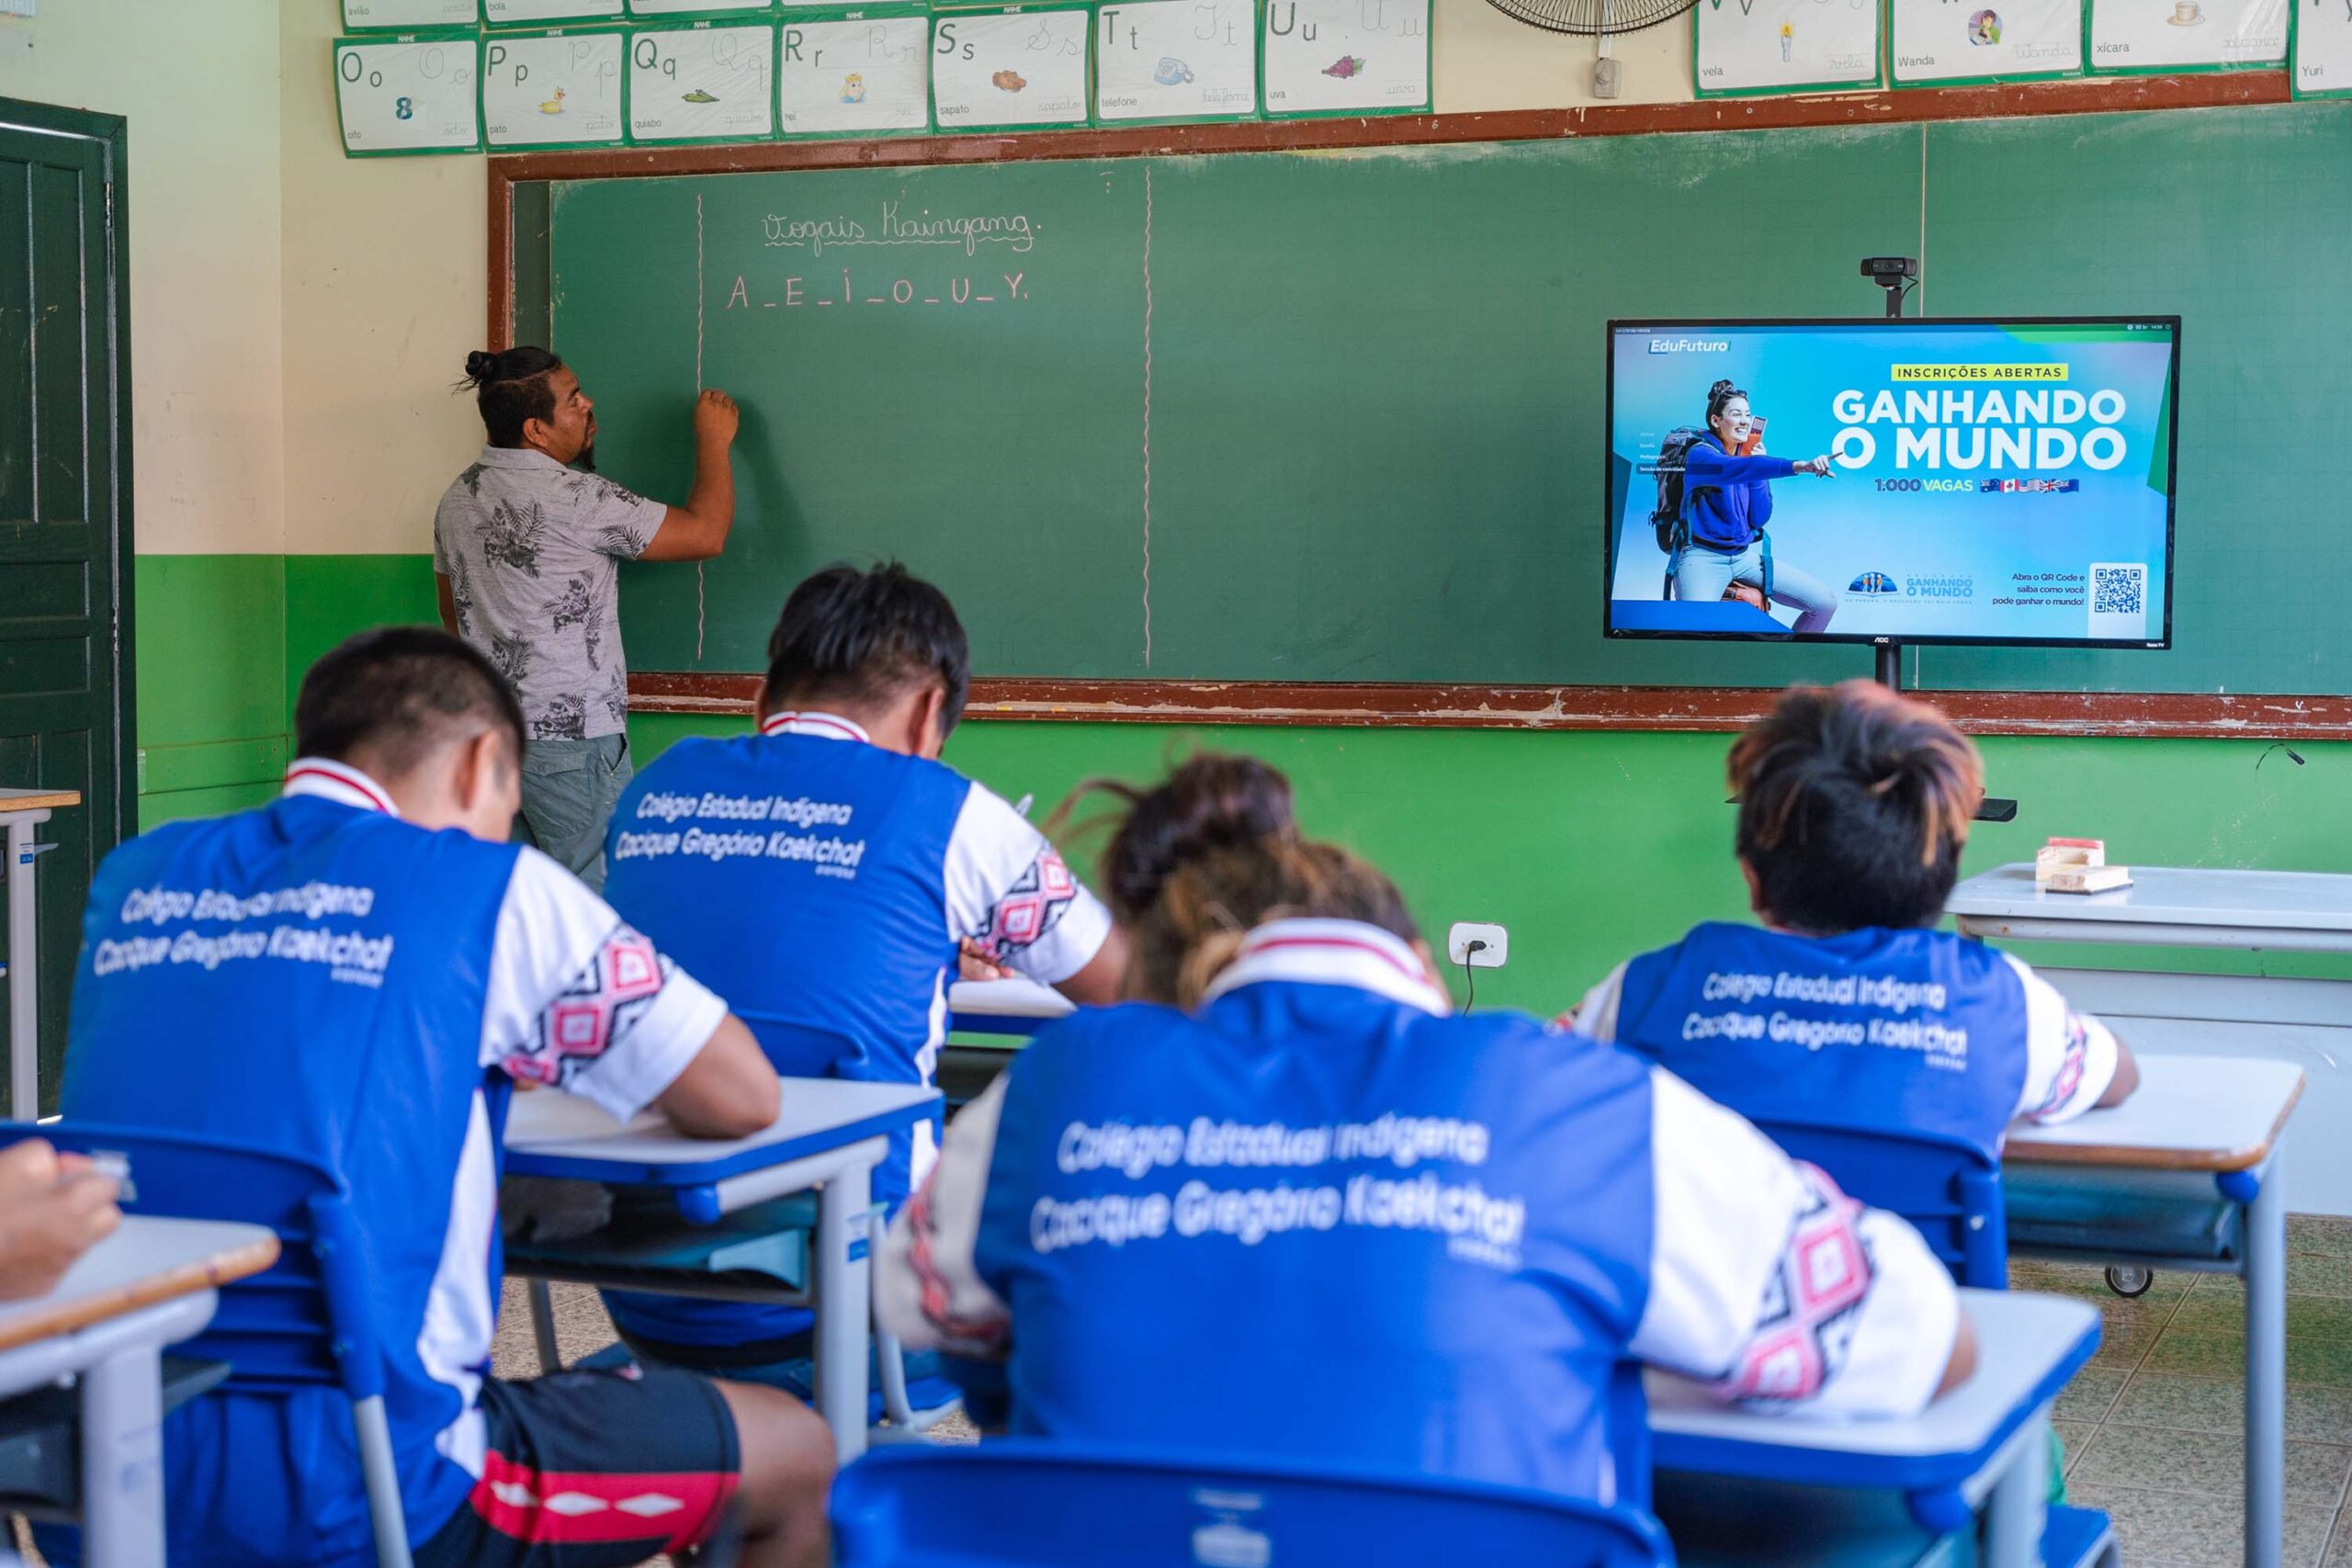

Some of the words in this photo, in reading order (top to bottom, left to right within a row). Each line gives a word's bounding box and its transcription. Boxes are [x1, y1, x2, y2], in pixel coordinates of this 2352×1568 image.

[1271, 2, 1295, 36] U
[1304, 23, 1316, 41] u
[1102, 11, 1120, 45] T
[1130, 26, 1138, 50] t
[937, 23, 956, 54] S
[962, 43, 975, 60] s
[786, 29, 803, 62] R
[815, 50, 823, 67] r
[488, 45, 506, 76] P
[515, 64, 528, 87] p
[635, 39, 658, 69] Q
[663, 58, 676, 81] q
[1898, 55, 1935, 67] Wanda
[341, 51, 363, 83] O
[1702, 66, 1724, 76] vela
[2302, 64, 2324, 76] Yuri
[1270, 90, 1286, 99] uva
[1102, 96, 1137, 107] telefone
[940, 104, 969, 115] sapato
[785, 111, 797, 121] rei
[490, 125, 507, 135] pato
[635, 119, 662, 130] quiabo
[1651, 339, 1728, 353] EduFuturo
[1897, 365, 1987, 379] INSCRIÇÕES
[1994, 367, 2062, 378] ABERTAS
[1832, 389, 2127, 424] GANHANDO
[1832, 426, 1876, 469] O
[1895, 426, 2127, 470] MUNDO
[1922, 479, 1973, 491] VAGAS
[1906, 578, 1973, 588] GANHANDO
[2041, 573, 2054, 581] QR
[1906, 587, 1917, 596] O
[1921, 587, 1973, 597] MUNDO
[2017, 585, 2039, 593] saiba
[1992, 597, 2014, 605] pode
[2016, 597, 2044, 605] ganhar
[696, 792, 773, 820] Estadual
